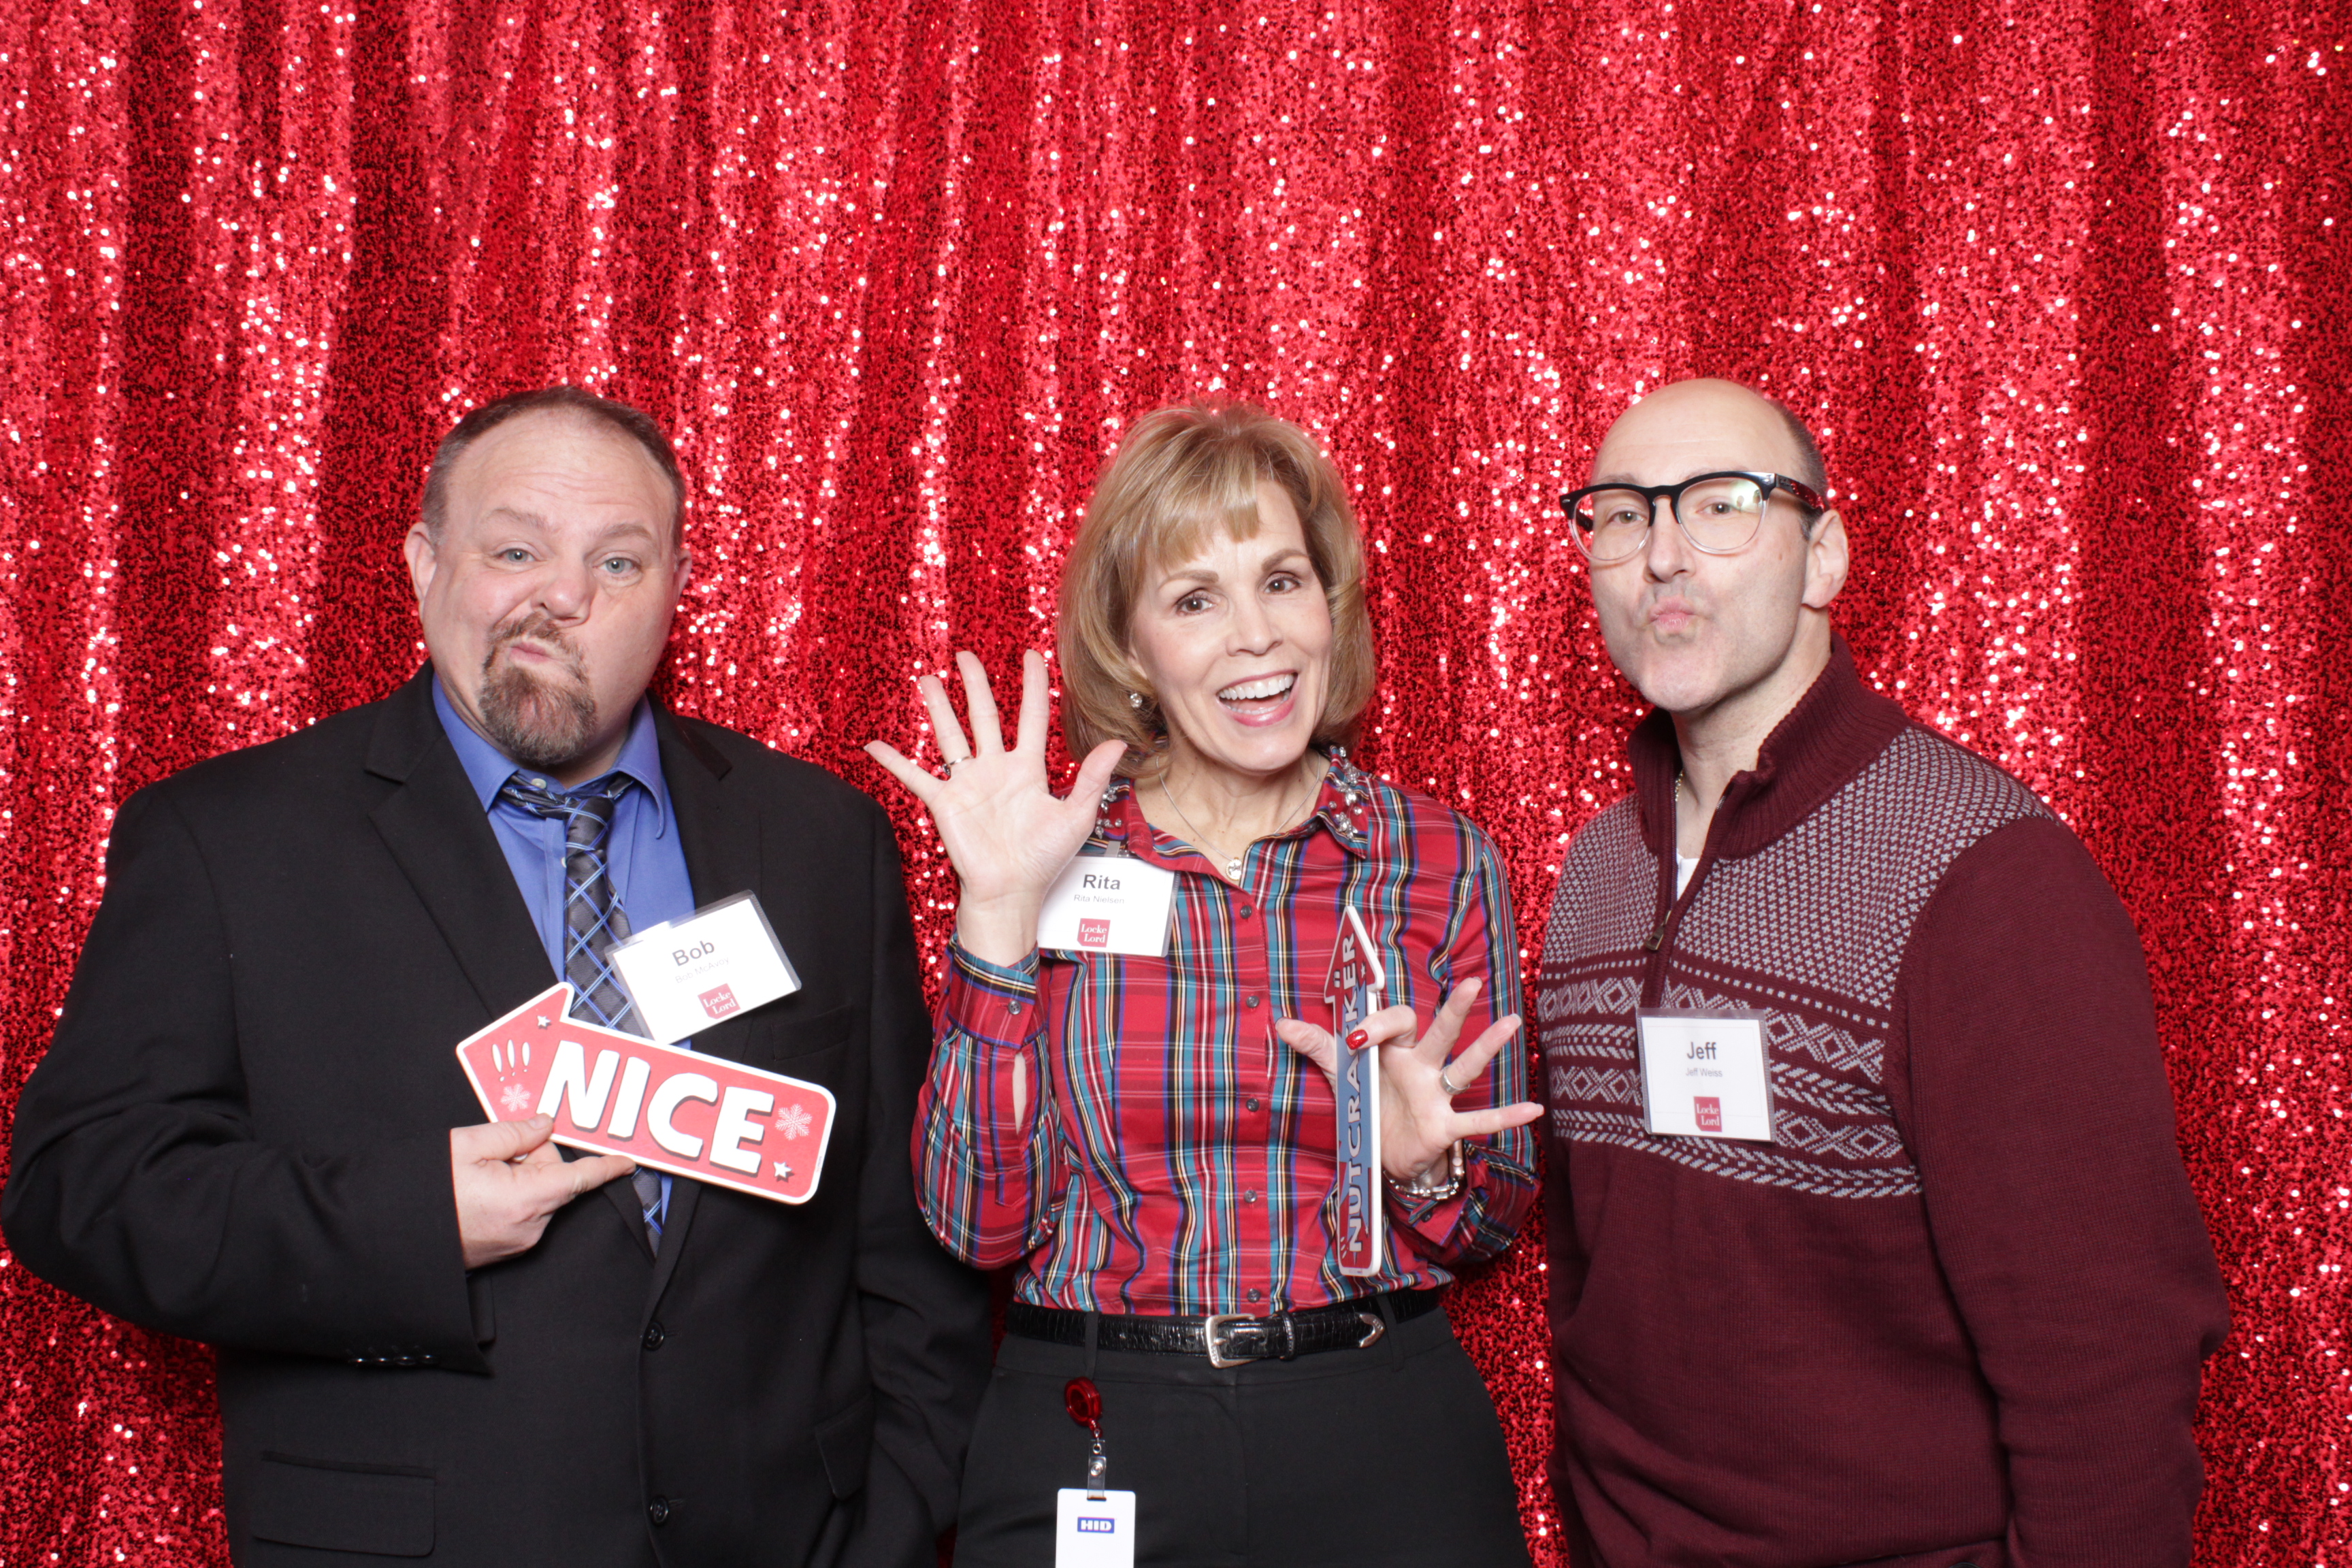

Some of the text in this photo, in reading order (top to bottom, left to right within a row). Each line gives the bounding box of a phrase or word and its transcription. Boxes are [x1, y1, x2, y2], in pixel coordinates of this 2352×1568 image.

[1083, 874, 1121, 890] Rita
[1074, 894, 1125, 904] Rita Nielsen
[1081, 924, 1107, 934] Locke
[1083, 934, 1106, 943] Lord
[672, 941, 715, 966] Bob
[675, 957, 730, 983] Bob McAvoy
[703, 992, 731, 1007] Locke
[712, 998, 736, 1015] Lord
[1686, 1041, 1717, 1060] Jeff
[1686, 1067, 1723, 1077] Jeff Weiss
[536, 1039, 774, 1175] NICE
[1696, 1103, 1719, 1115] Locke
[1701, 1115, 1720, 1126] Lord
[1080, 1519, 1113, 1531] HID
